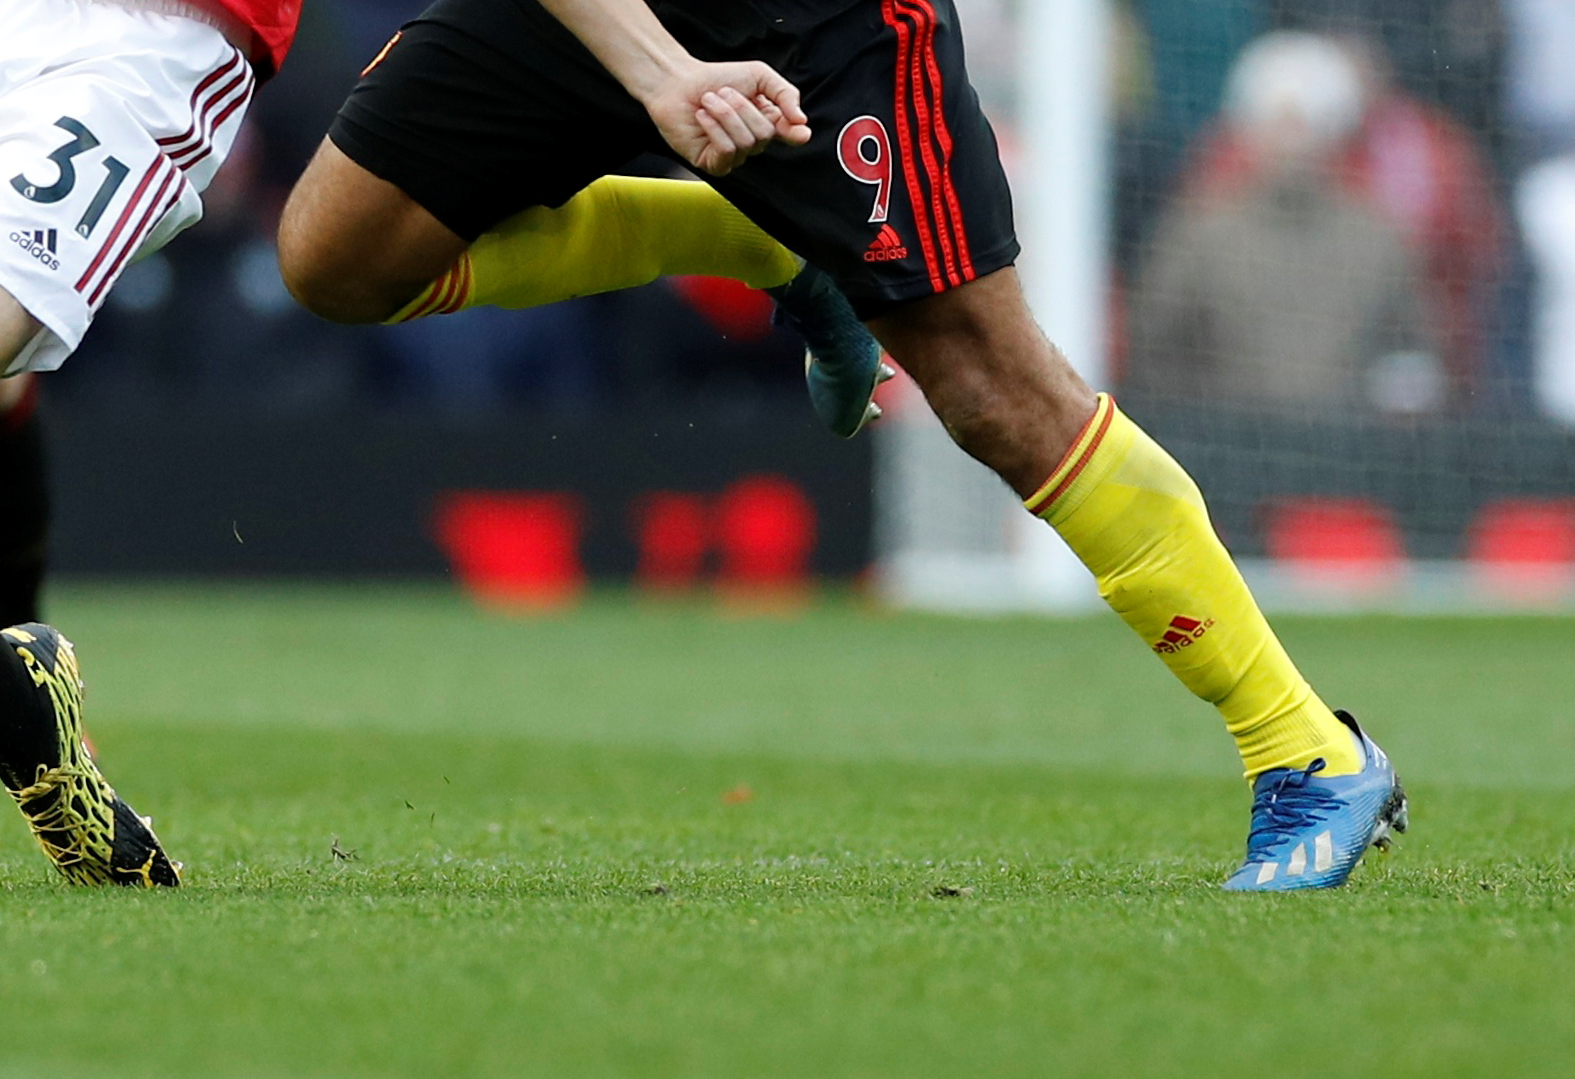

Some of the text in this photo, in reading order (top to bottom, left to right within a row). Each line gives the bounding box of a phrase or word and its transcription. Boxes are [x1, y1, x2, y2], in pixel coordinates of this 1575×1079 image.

[9, 115, 131, 240] 31
[837, 115, 893, 222] 9
[9, 231, 61, 271] adidas
[863, 246, 908, 262] adidas
